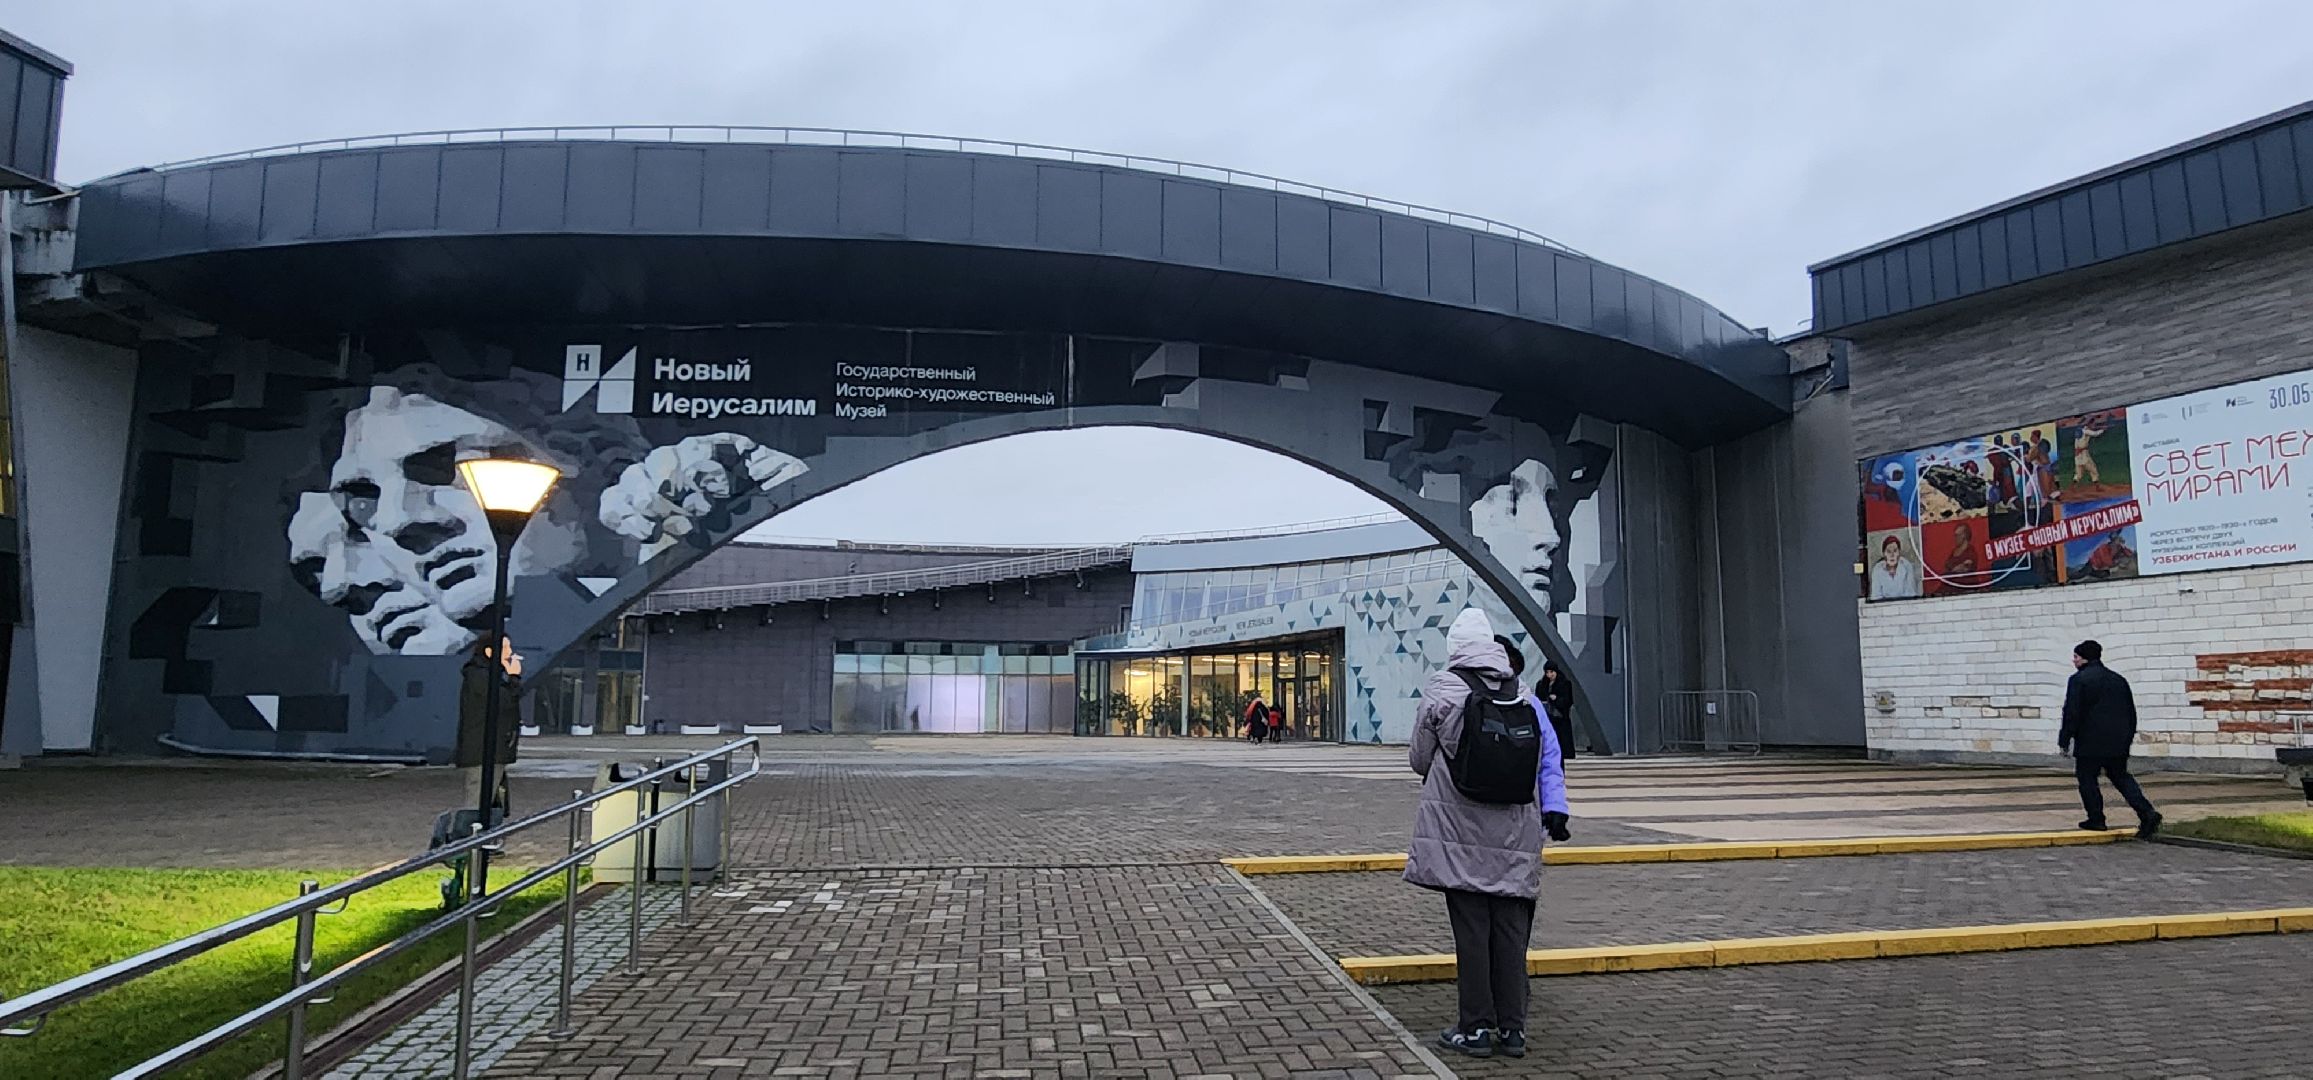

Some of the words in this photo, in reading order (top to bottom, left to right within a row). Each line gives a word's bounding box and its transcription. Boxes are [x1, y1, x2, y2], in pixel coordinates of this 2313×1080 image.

[654, 358, 751, 382] Новый
[836, 362, 976, 381] Государственный
[652, 392, 816, 419] Иерусалим
[835, 382, 1055, 406] Историко-художественный
[835, 402, 888, 420] Музей
[2145, 441, 2232, 478] СВЕТ
[2146, 462, 2290, 506] МИРАМИ
[1985, 543, 1993, 560] В
[1994, 534, 2026, 558] МУЗЕЕ
[2028, 521, 2069, 547] «НОВЫЙ
[2071, 504, 2140, 537] ИЕРУСАЛИМ»
[2152, 550, 2230, 565] УЗБЕКИСТАНА
[2246, 543, 2297, 555] РОССИИ
